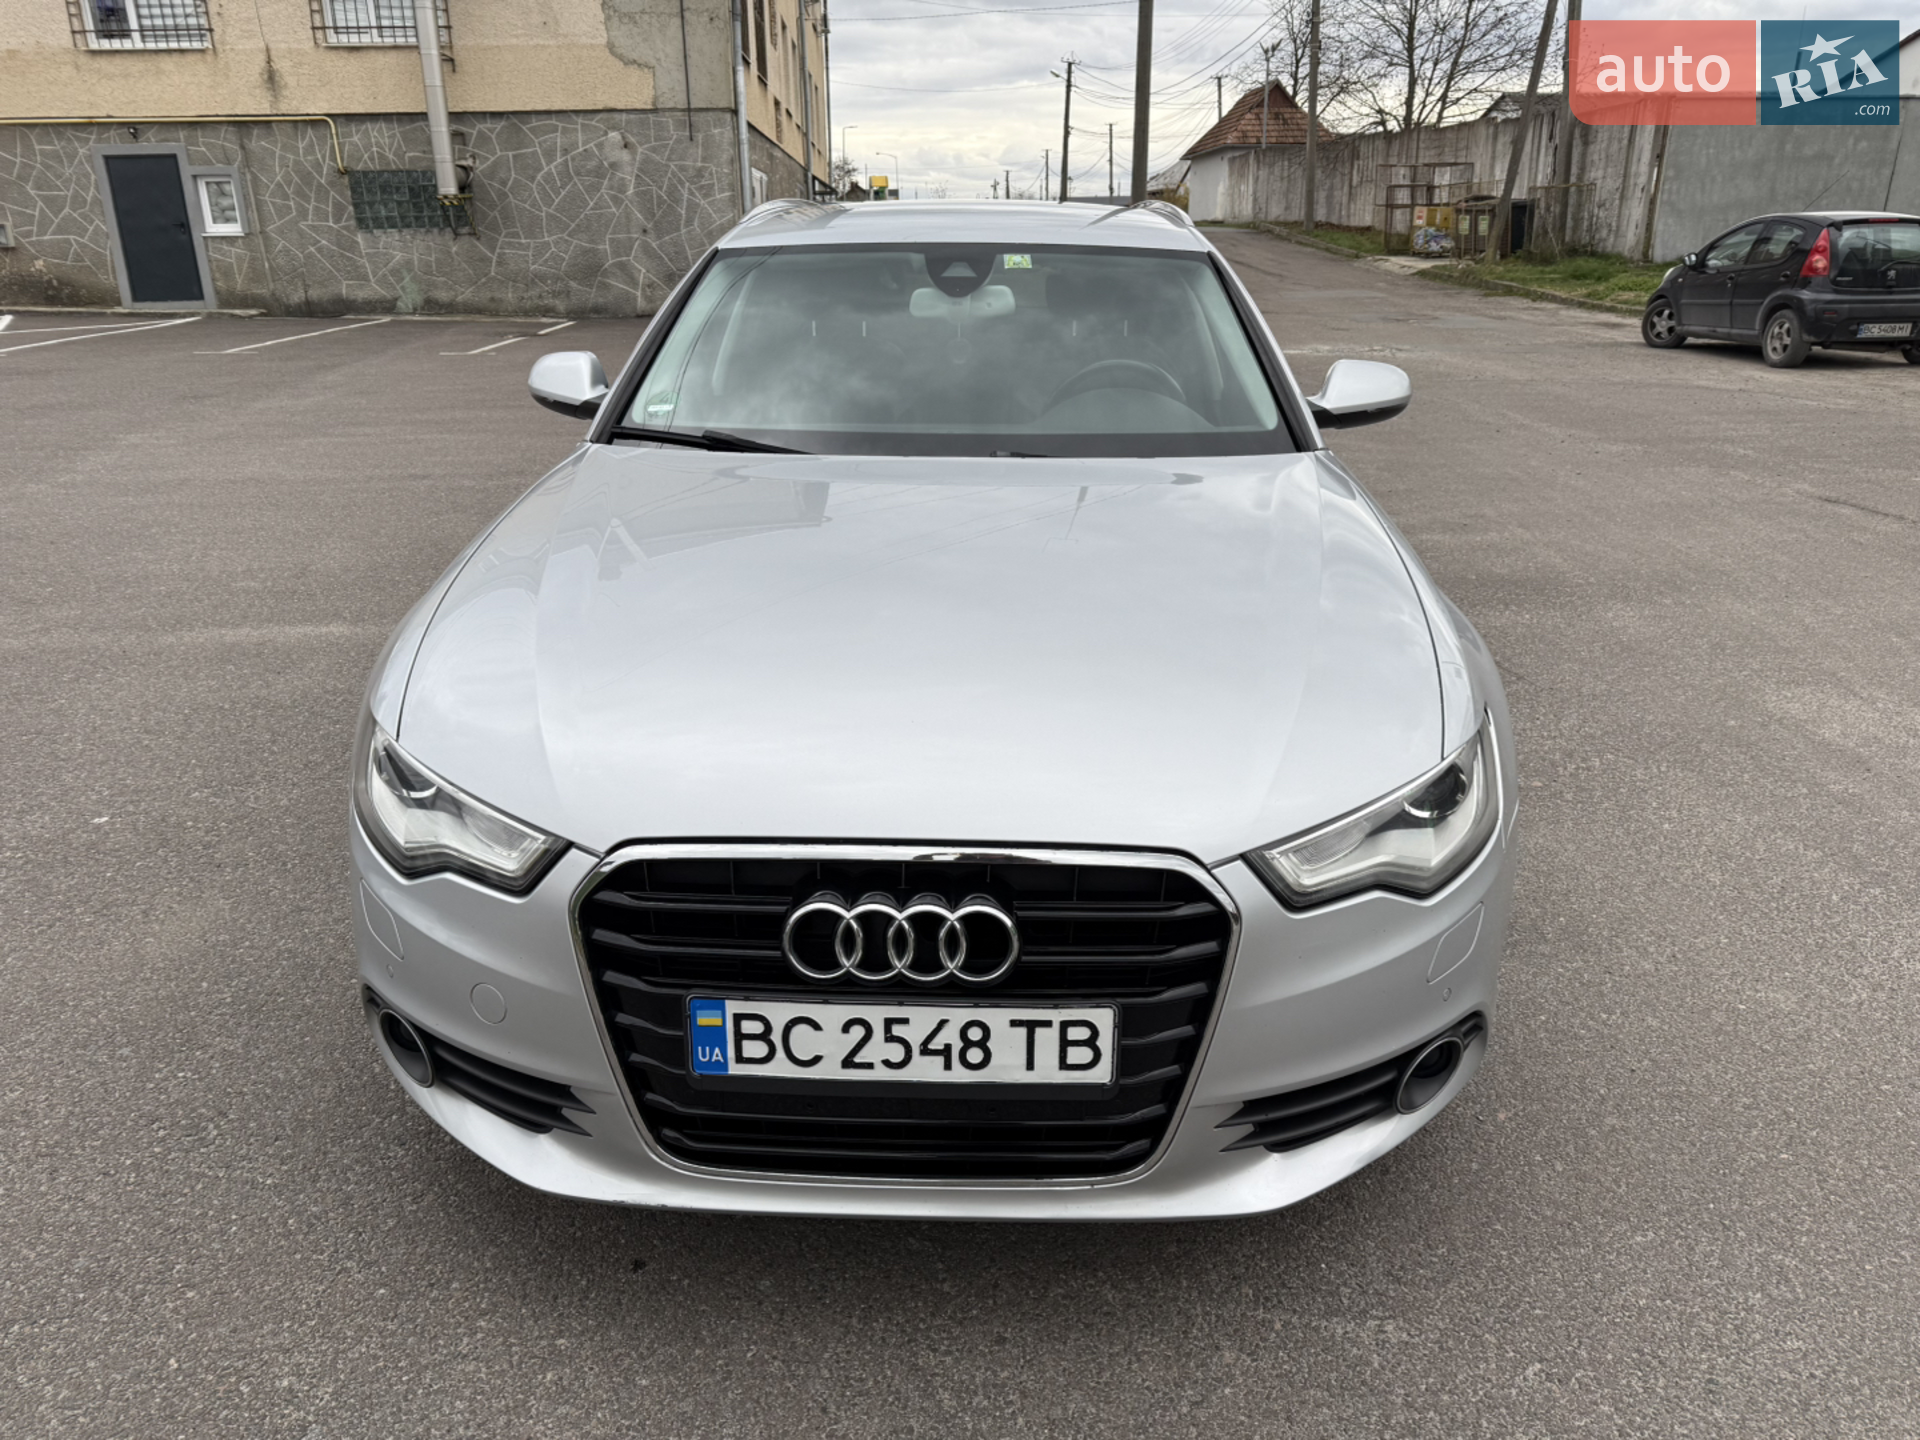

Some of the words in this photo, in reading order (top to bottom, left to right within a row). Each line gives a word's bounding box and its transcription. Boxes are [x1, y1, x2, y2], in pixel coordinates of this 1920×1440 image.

[697, 1046, 725, 1064] UA
[732, 1012, 825, 1069] BC
[840, 1016, 993, 1071] 2548
[1009, 1018, 1103, 1071] TB
